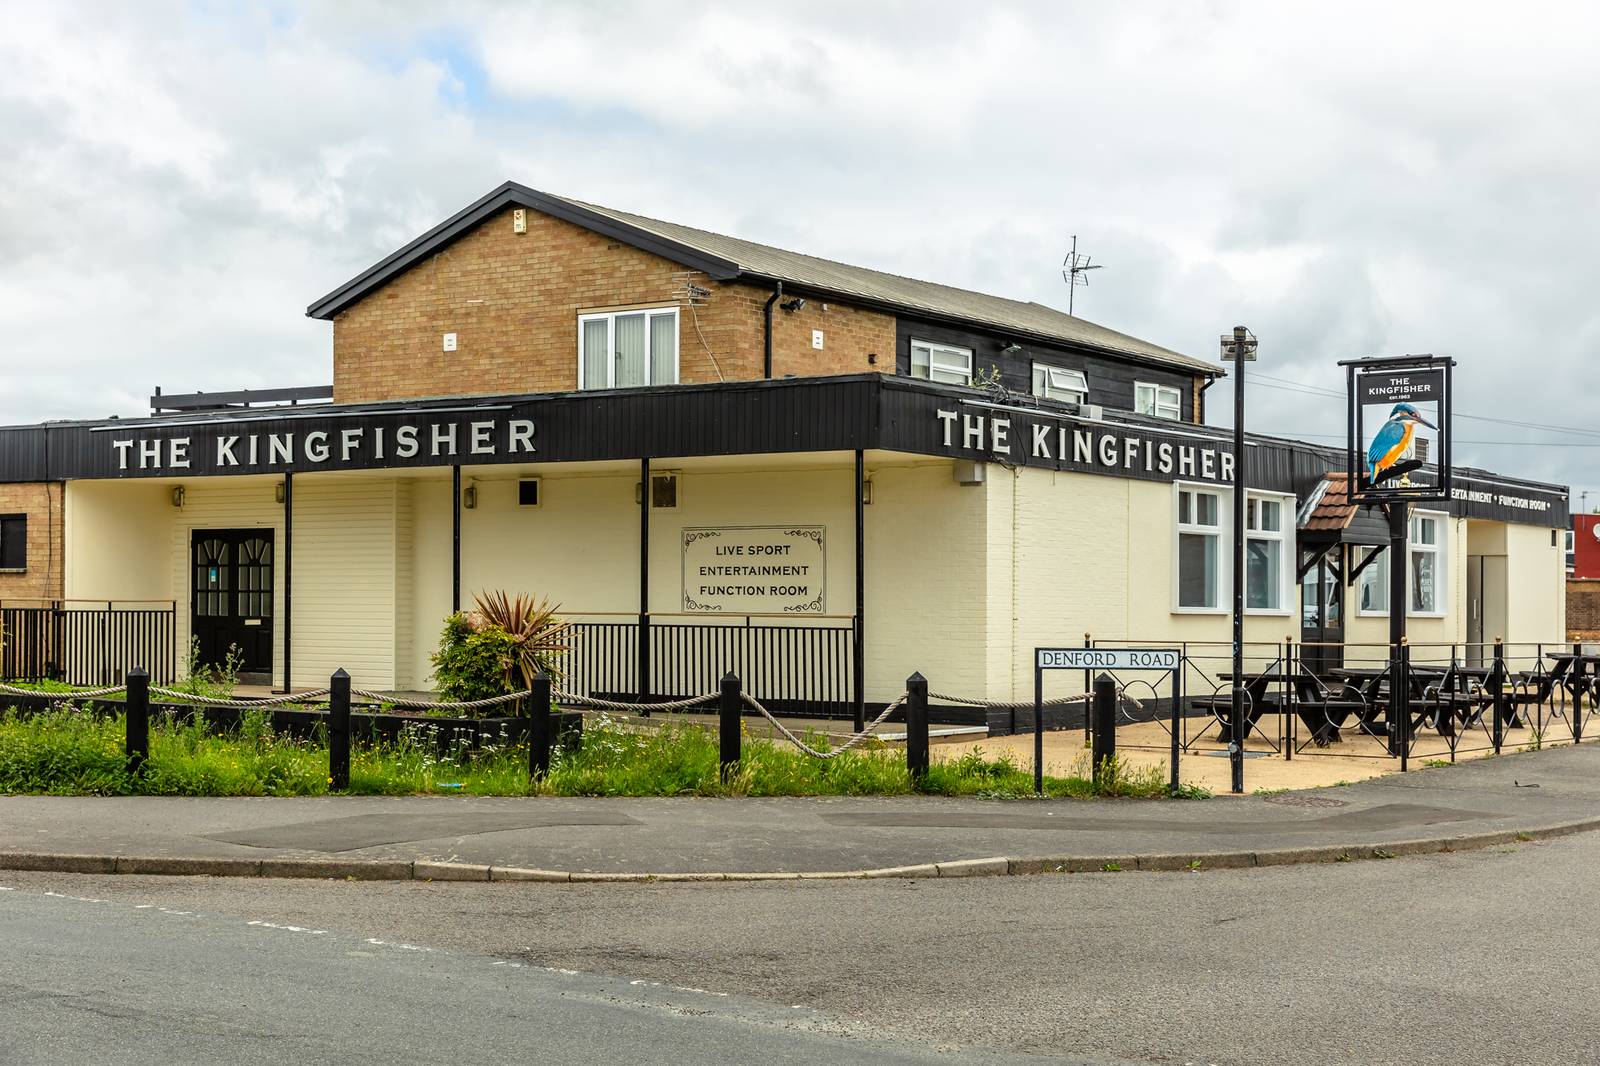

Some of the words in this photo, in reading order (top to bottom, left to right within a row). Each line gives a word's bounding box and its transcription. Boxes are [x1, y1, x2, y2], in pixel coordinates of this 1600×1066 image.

[1389, 377, 1410, 386] THE
[1368, 384, 1431, 395] KINGFISHER
[112, 437, 191, 470] THE
[216, 419, 537, 467] KINGFISHER
[937, 408, 1011, 454] THE
[1031, 424, 1235, 481] KINGFISHER
[1499, 495, 1528, 509] FUNCTION
[1529, 500, 1546, 511] ROOM
[715, 546, 744, 556] LIVE
[748, 545, 791, 555] SPORT
[699, 566, 809, 576] ENTERTAINMENT
[700, 586, 765, 596] FUNCTION
[770, 586, 808, 596] ROOM
[1042, 652, 1117, 666] DENFORD
[1129, 653, 1175, 666] ROAD
